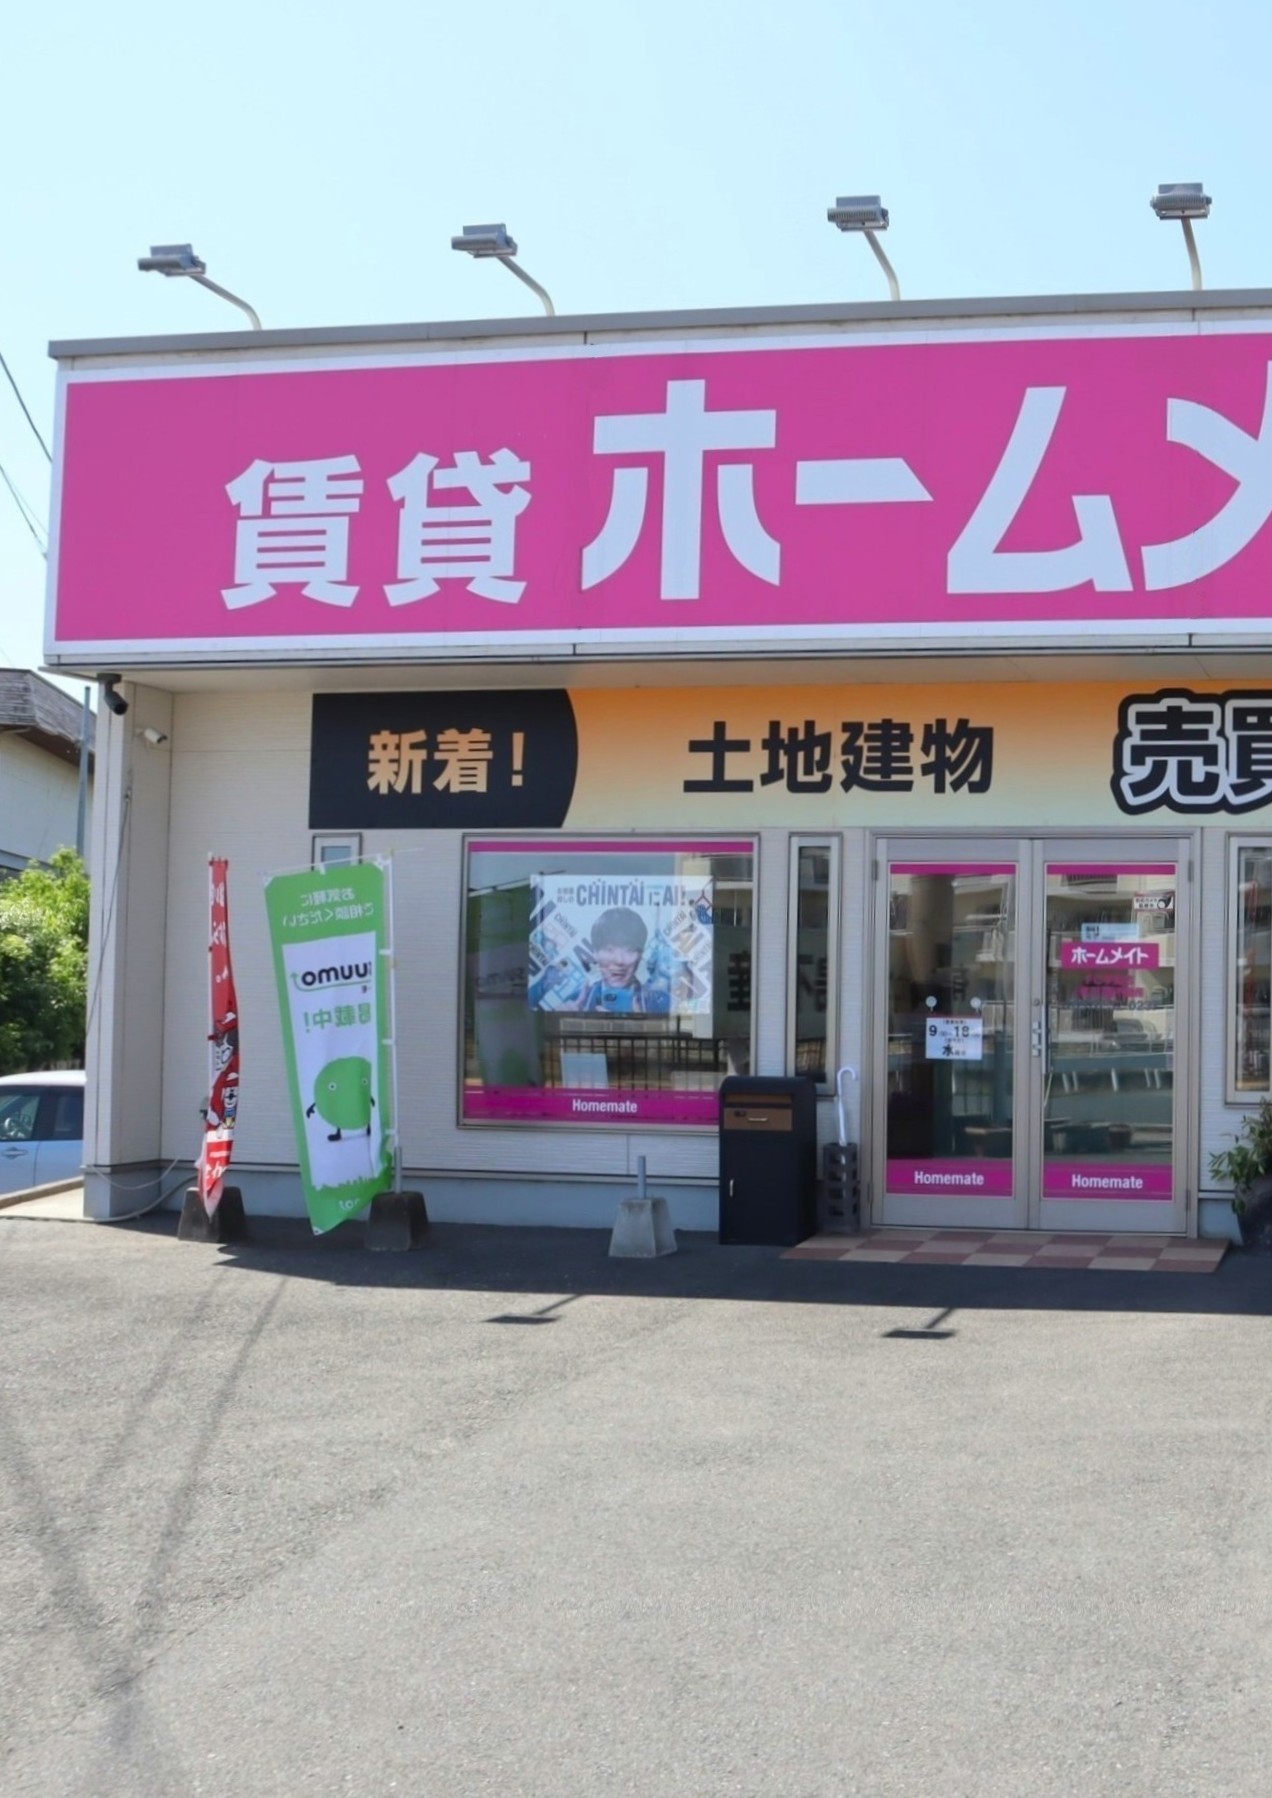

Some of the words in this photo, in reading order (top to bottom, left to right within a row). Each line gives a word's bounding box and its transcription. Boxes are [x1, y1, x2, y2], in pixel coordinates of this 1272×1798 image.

[219, 447, 532, 610] 賃貸
[366, 727, 526, 795] 新着!
[682, 717, 995, 795] 土地建物
[1071, 946, 1150, 965] ホームメイト
[572, 1098, 638, 1114] Homemate
[914, 1170, 985, 1186] Homemate
[1071, 1173, 1144, 1190] Homemate
